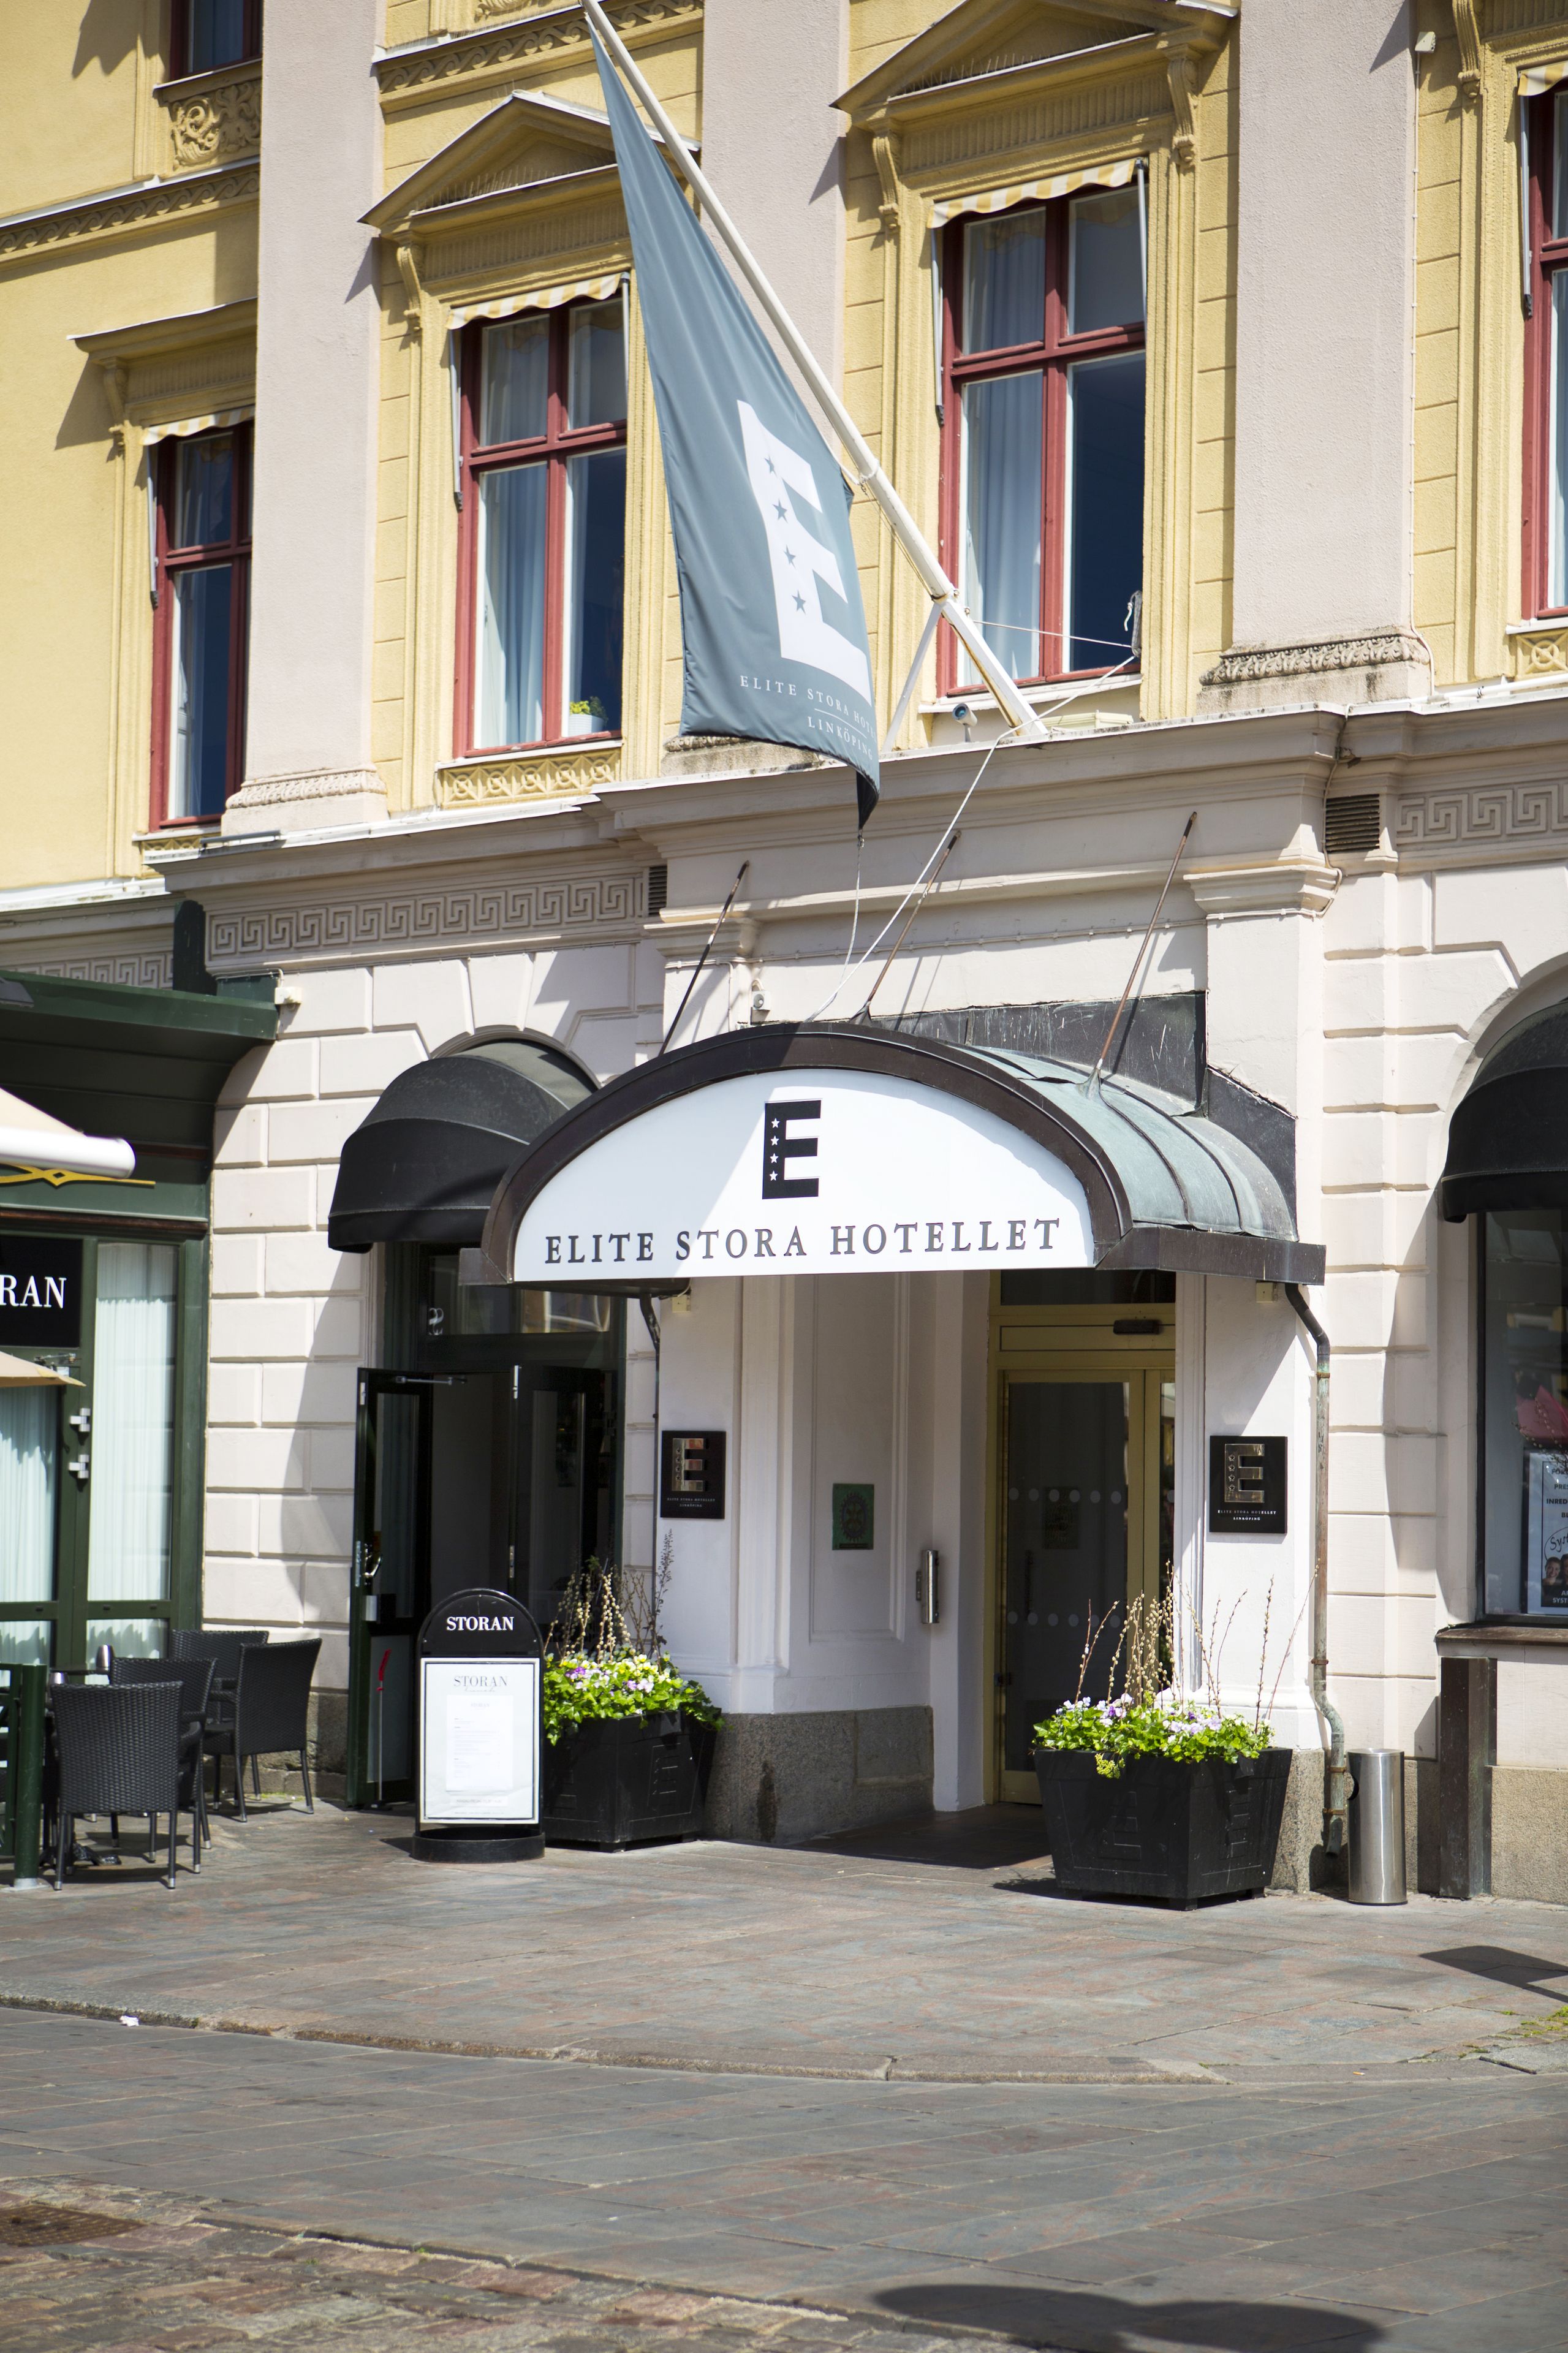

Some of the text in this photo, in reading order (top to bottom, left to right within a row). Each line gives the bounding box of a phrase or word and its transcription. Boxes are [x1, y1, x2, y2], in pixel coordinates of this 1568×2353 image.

[740, 675, 797, 696] ELITE
[807, 688, 849, 716] STORA
[808, 716, 873, 760] LINKÖPING
[762, 1098, 822, 1200] E
[545, 1218, 1060, 1264] ELITE STORA HOTELLET
[0, 1275, 67, 1309] RAN
[446, 1616, 515, 1631] STORAN
[453, 1675, 508, 1687] STORAN
